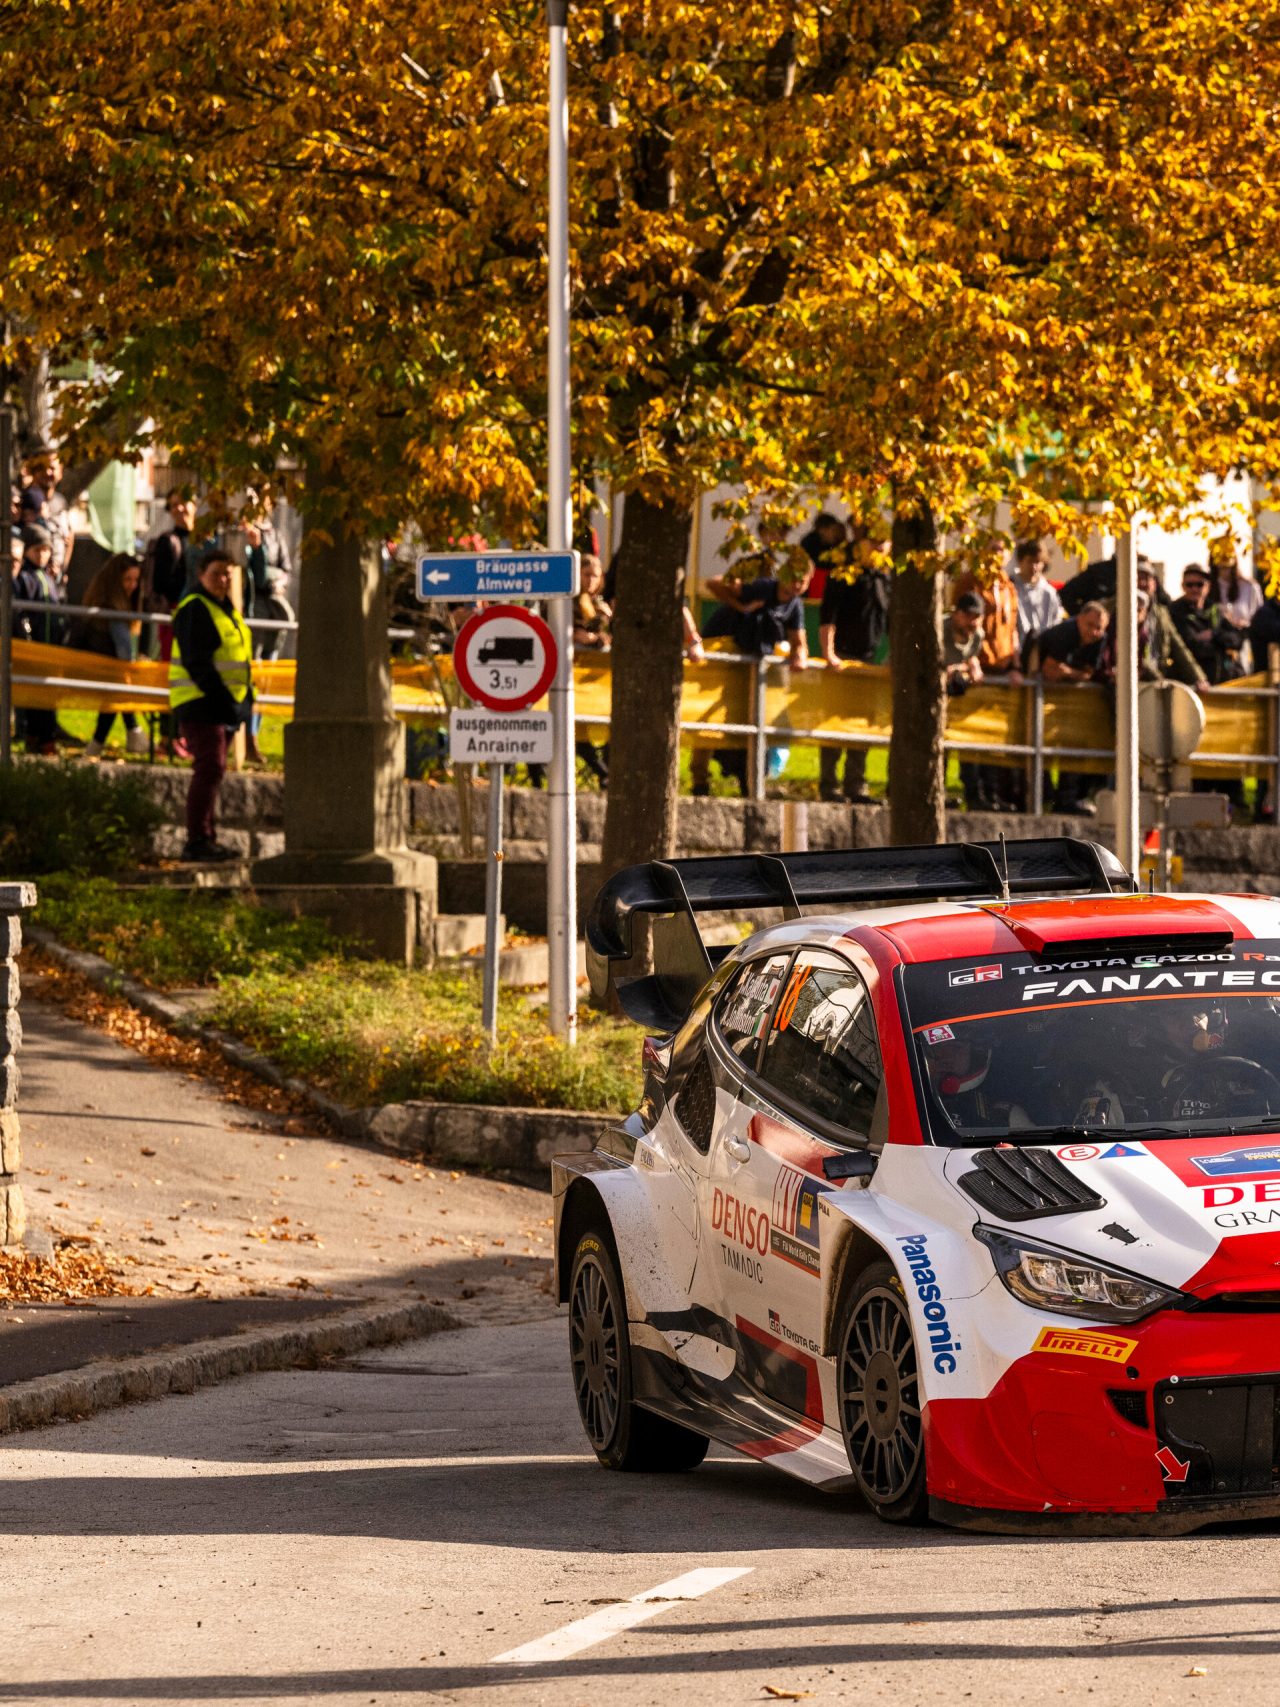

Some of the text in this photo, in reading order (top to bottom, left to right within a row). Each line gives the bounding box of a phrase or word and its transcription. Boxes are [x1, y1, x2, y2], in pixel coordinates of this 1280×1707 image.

[476, 560, 549, 576] Bräugasse
[476, 577, 533, 593] Almweg
[456, 718, 548, 735] ausgenommen
[466, 736, 537, 753] Anrainer
[1011, 957, 1127, 976] TOYOTA
[1133, 953, 1236, 967] GAZOO
[951, 968, 1002, 984] GR
[1069, 1147, 1089, 1158] E
[711, 1187, 770, 1257] DENSO
[721, 1243, 764, 1285] TAMADIC
[896, 1234, 962, 1376] Panasonic
[782, 1323, 808, 1348] TOYOTA
[1041, 1330, 1128, 1359] PIRELLI
